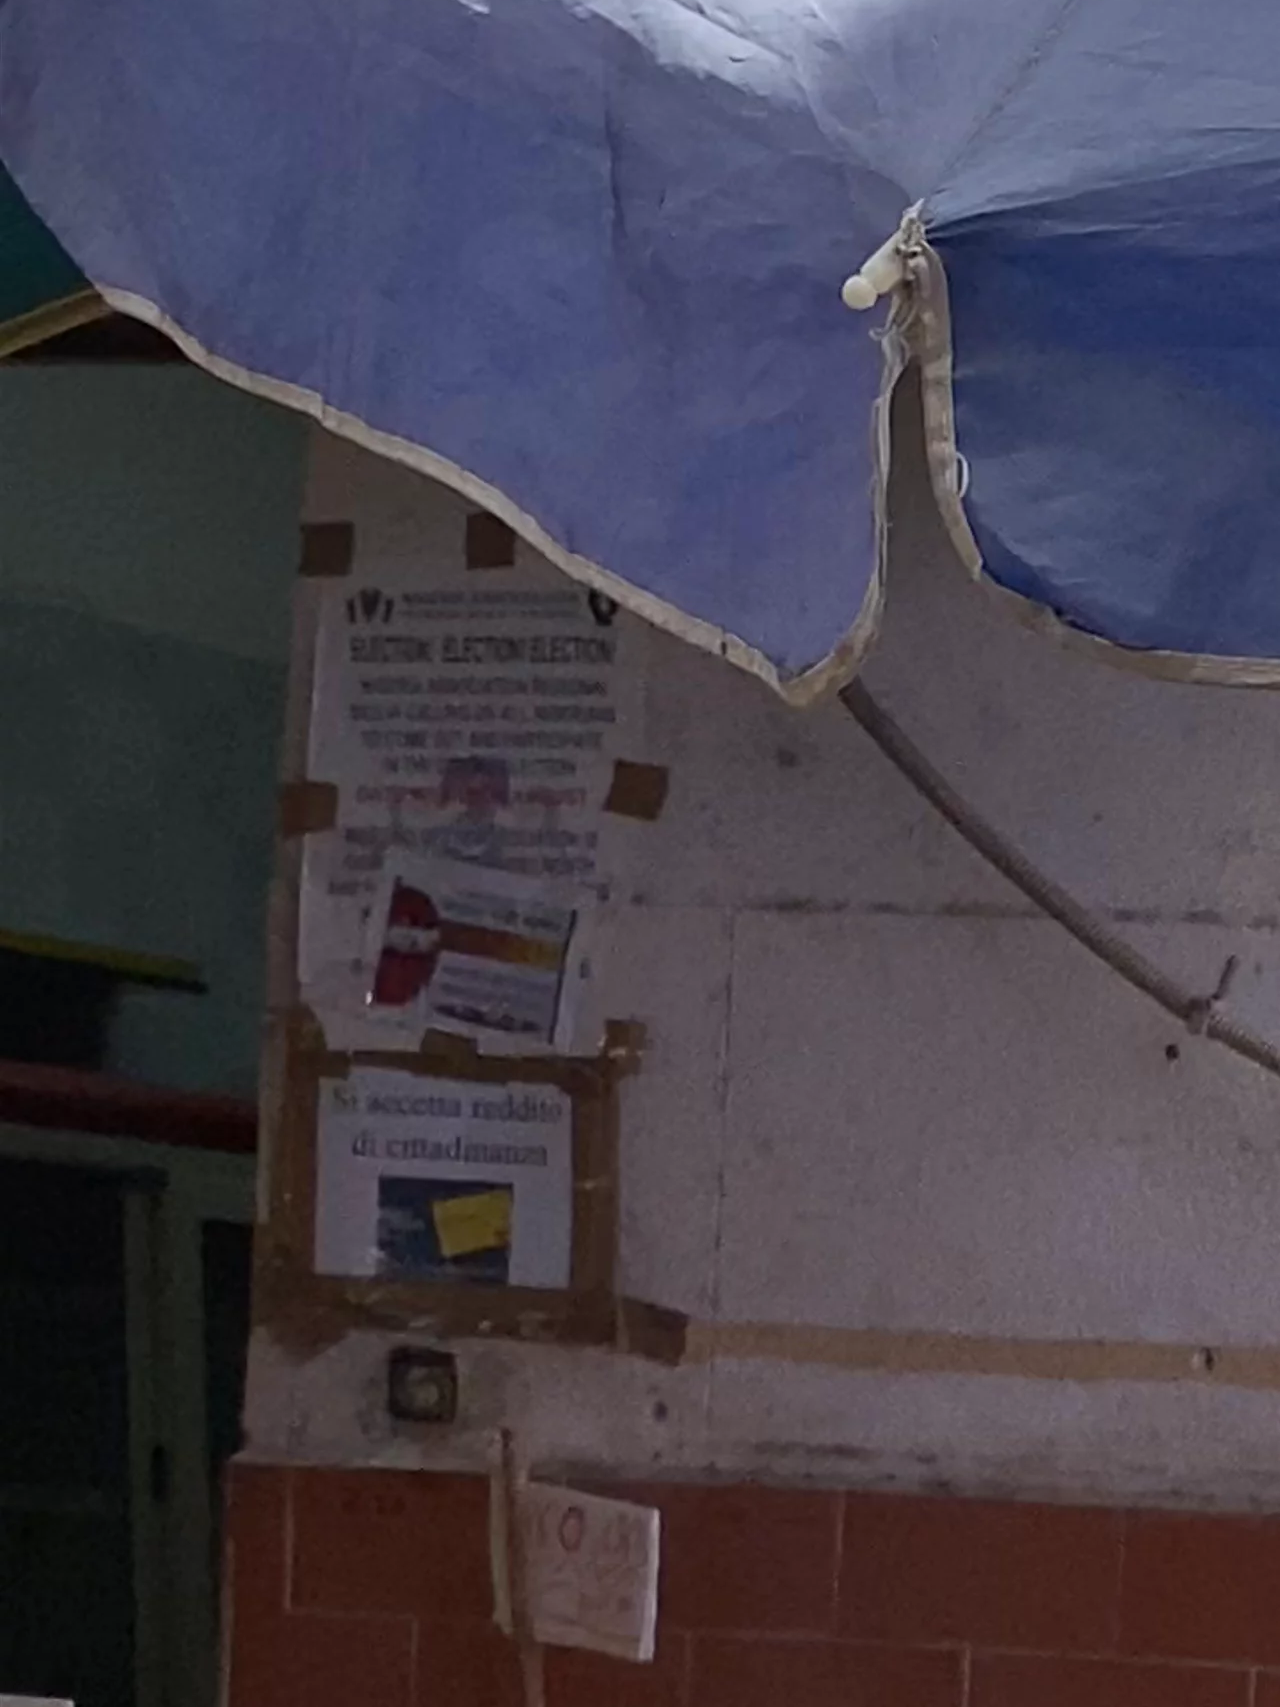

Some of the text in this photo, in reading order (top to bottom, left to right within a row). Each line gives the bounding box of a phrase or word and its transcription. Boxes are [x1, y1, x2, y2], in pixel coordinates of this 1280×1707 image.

[366, 1093, 462, 1117] accetta
[470, 1092, 564, 1125] reddito
[351, 1131, 549, 1167] di cittadinanza
